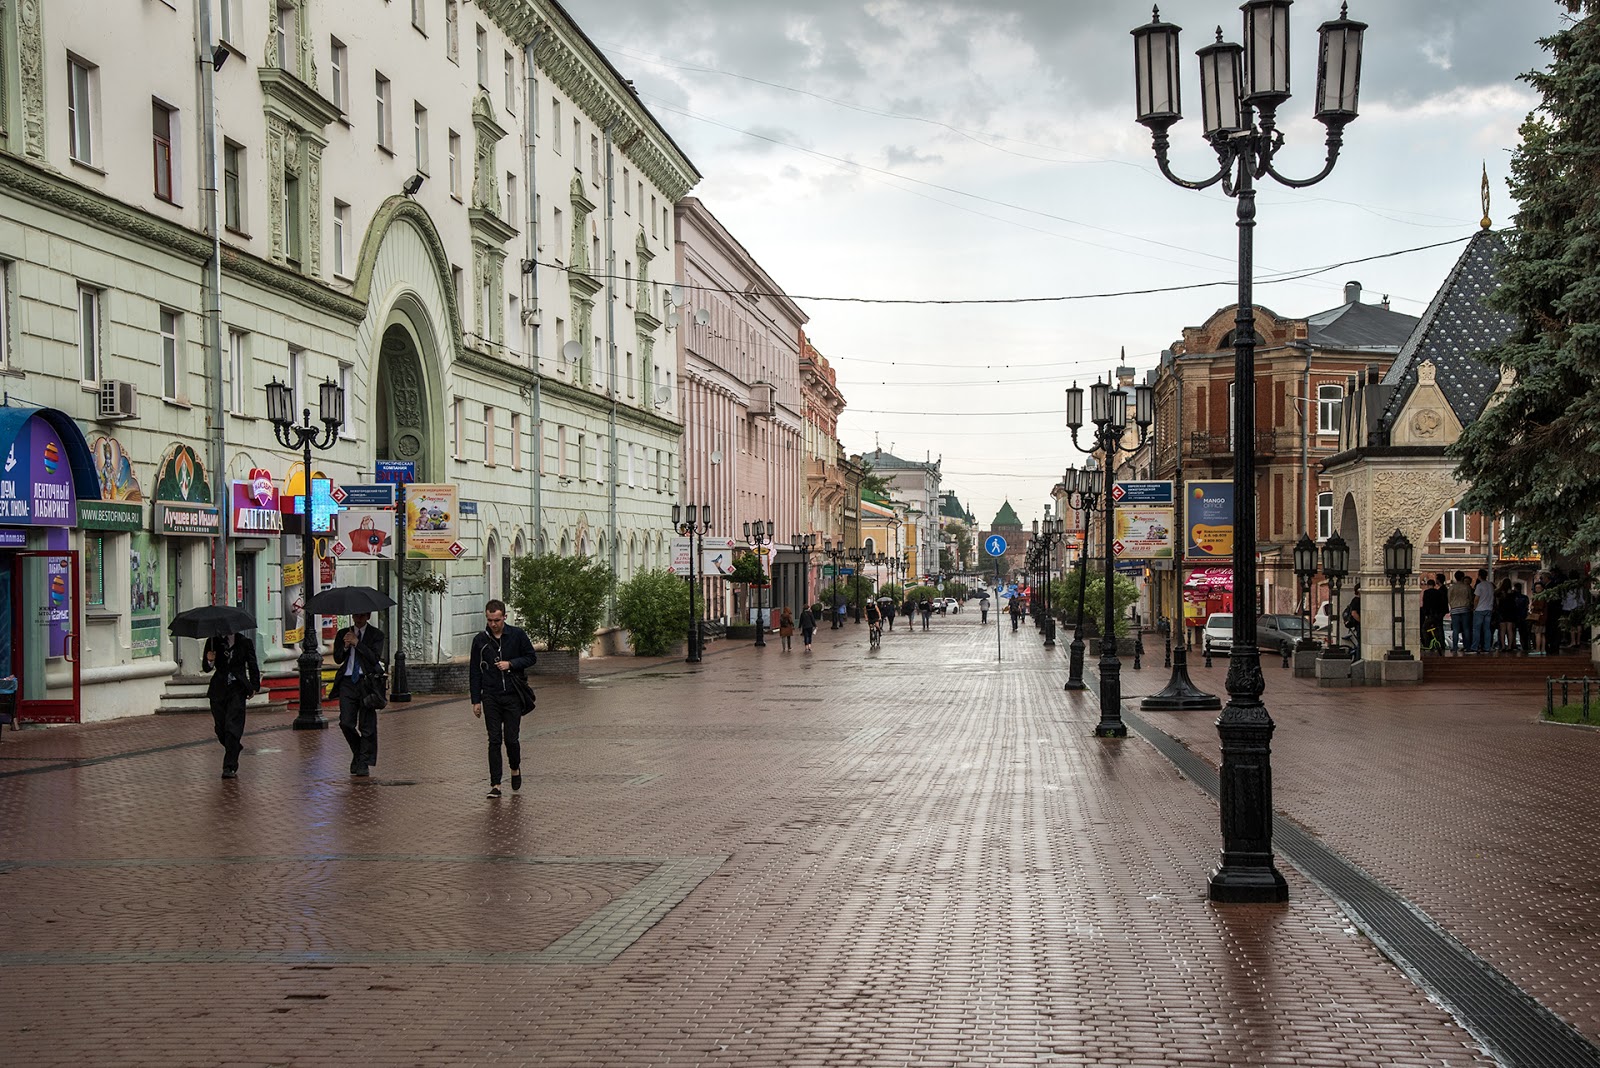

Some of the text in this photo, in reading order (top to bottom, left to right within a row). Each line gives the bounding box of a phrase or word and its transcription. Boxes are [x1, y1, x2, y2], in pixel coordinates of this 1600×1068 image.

[34, 481, 70, 500] ЛЕНТОЧНЫЙ
[34, 500, 69, 518] ЛАБИРИНТ
[81, 509, 139, 523] WWW.BESTOFINDIA.RU
[164, 507, 219, 528] Лучшее из Индии
[239, 508, 284, 531] АПТЕКА
